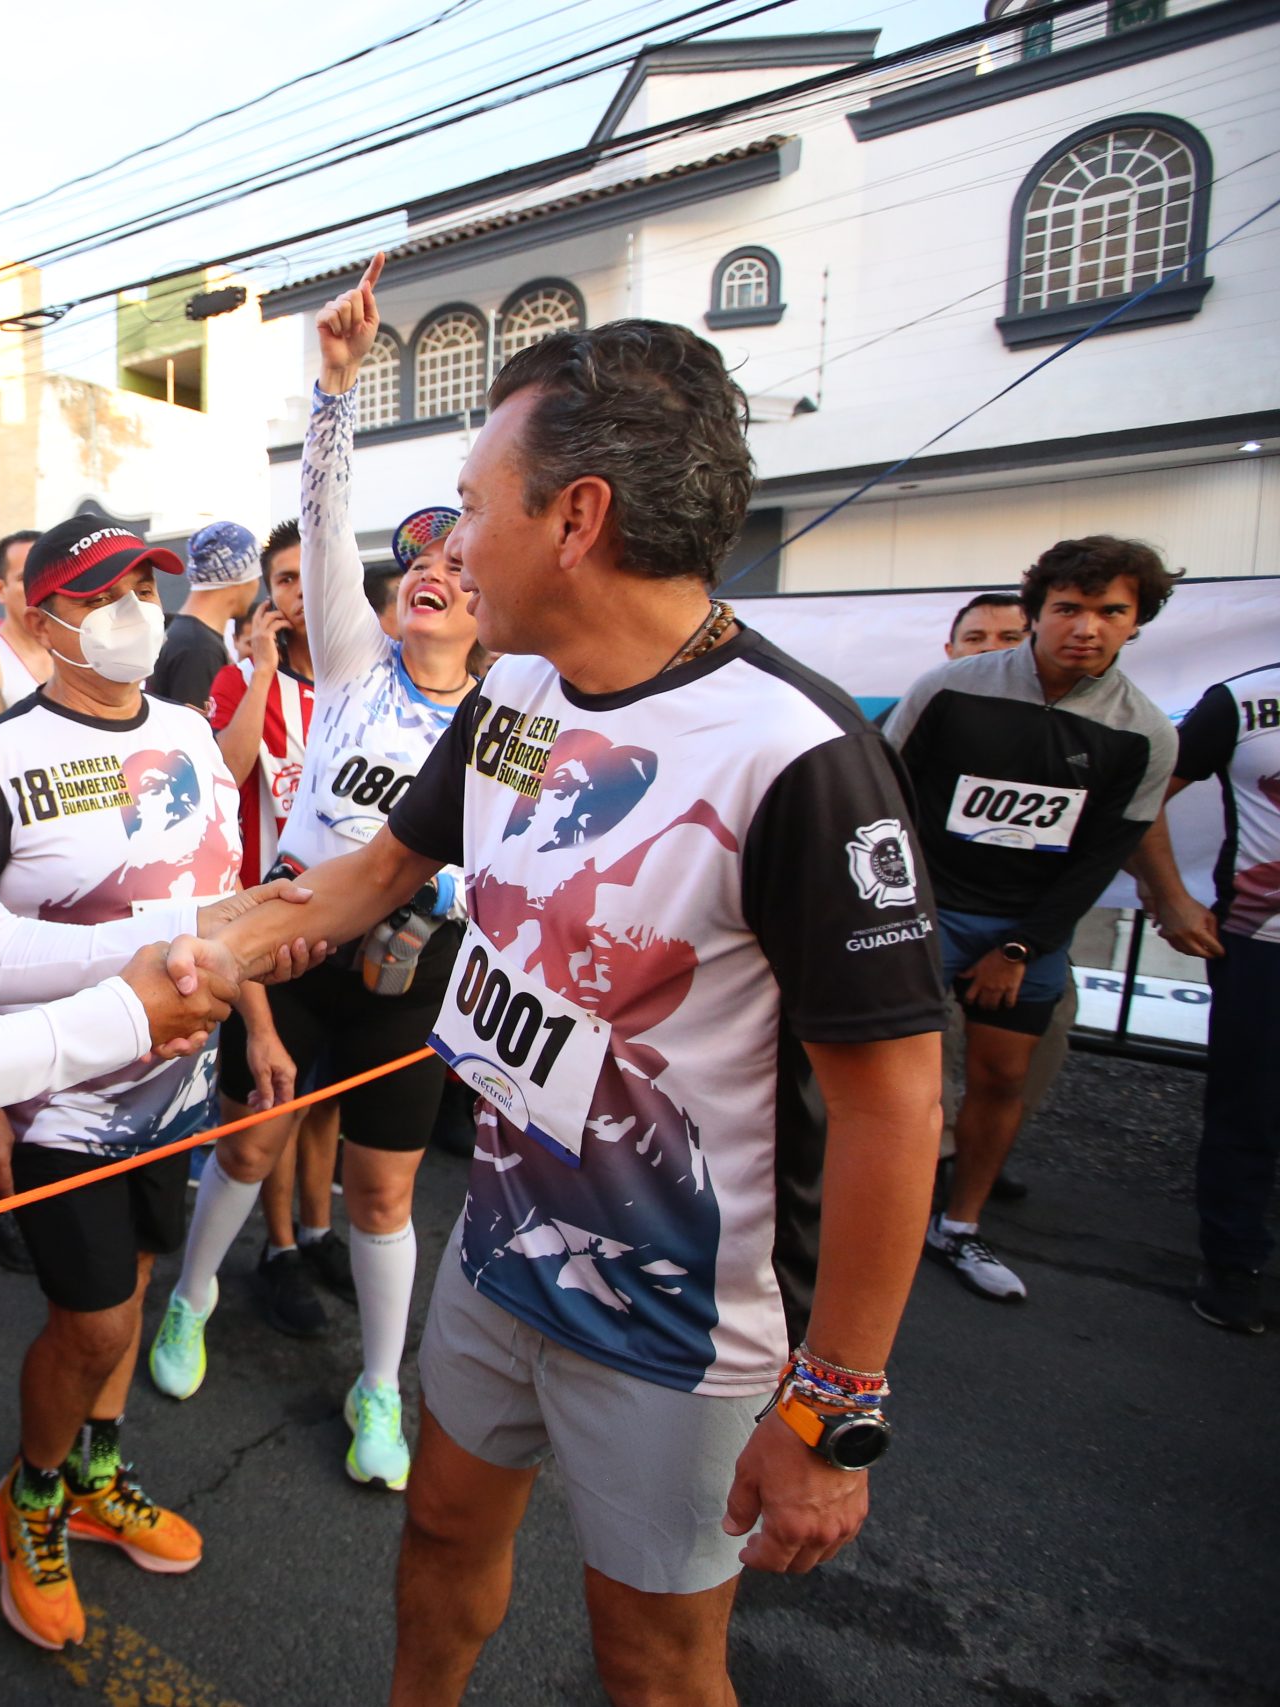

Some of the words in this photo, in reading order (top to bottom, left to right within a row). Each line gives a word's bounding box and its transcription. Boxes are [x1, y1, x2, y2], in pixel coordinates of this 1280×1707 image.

[56, 773, 128, 800] BOMBEROS
[60, 755, 121, 778] CARRERA
[331, 755, 417, 815] 080
[61, 792, 133, 815] GUADALAJARA
[962, 785, 1070, 828] 0023
[456, 944, 577, 1088] 0001
[472, 1071, 514, 1112] Electrolit
